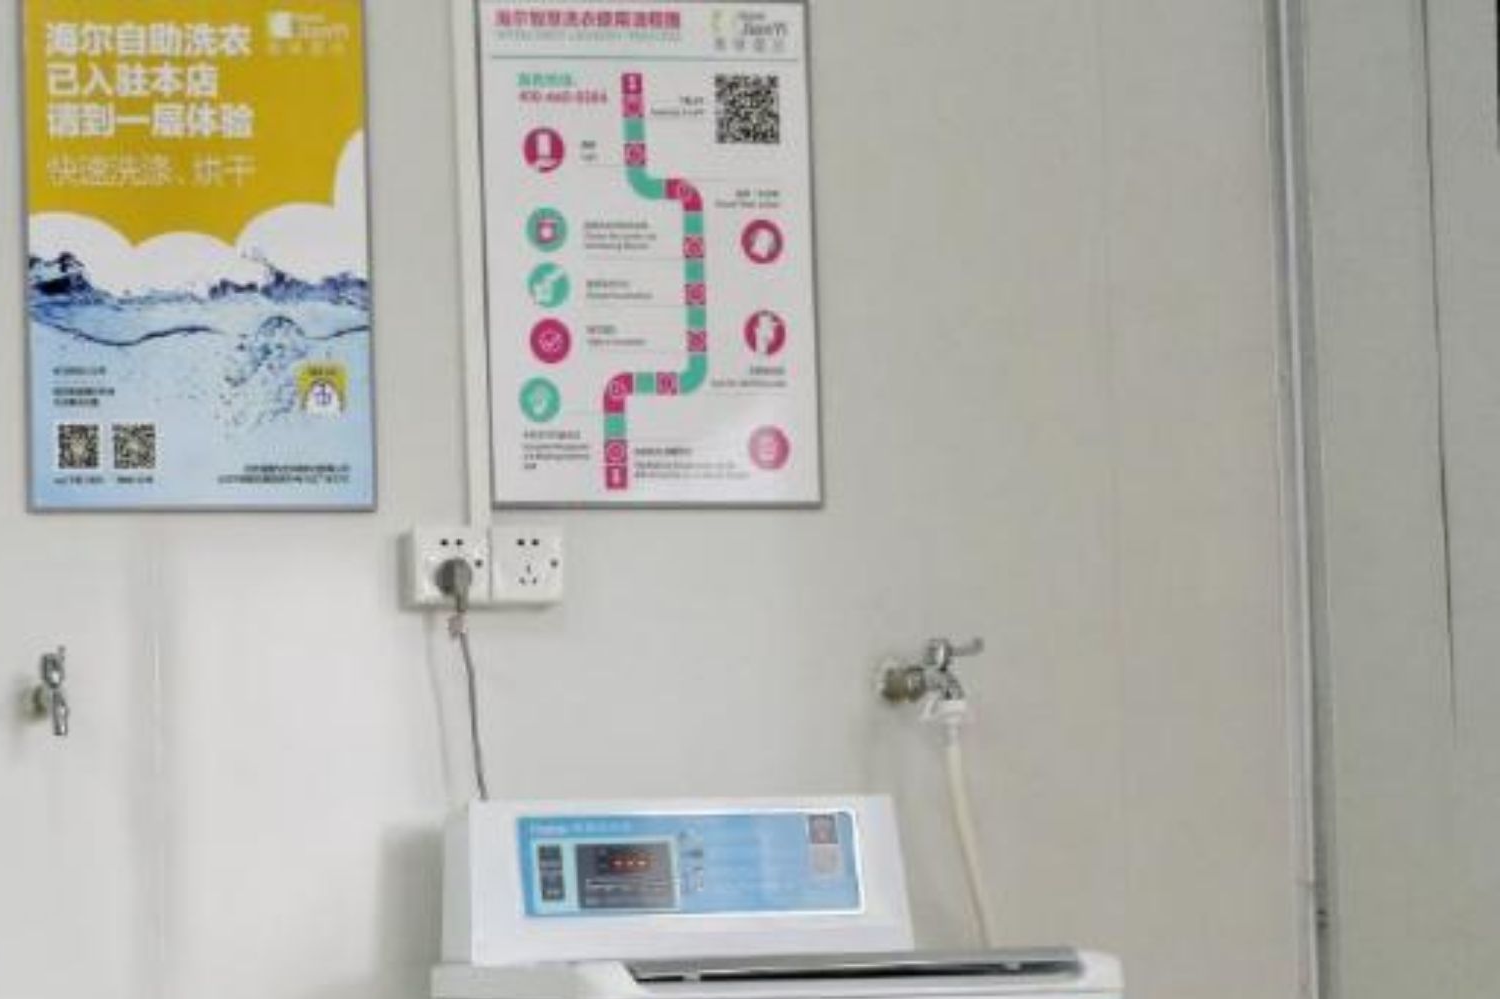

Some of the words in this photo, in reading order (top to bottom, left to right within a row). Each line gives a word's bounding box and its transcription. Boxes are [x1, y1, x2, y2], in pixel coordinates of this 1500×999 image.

[47, 23, 251, 56] 海尔自助洗衣
[47, 62, 219, 97] 已入驻本店
[47, 102, 254, 138] 请到一层体验
